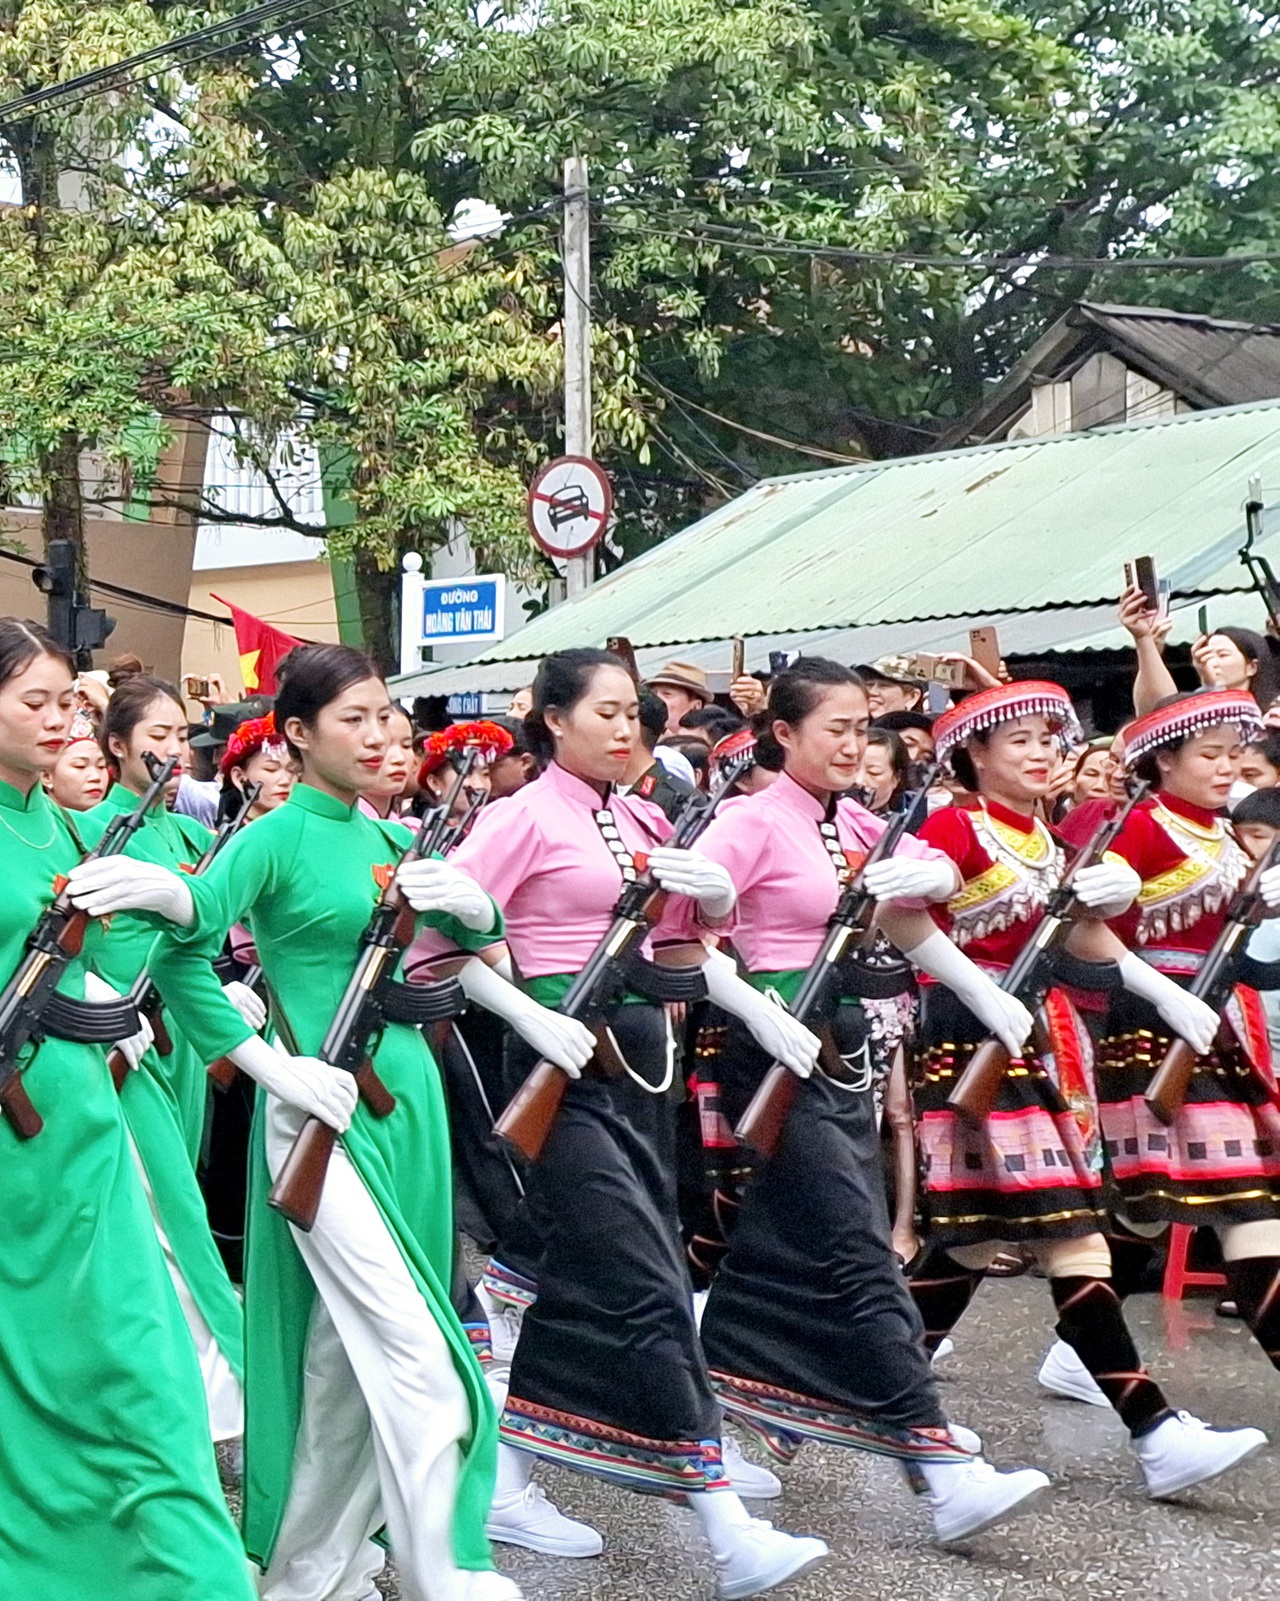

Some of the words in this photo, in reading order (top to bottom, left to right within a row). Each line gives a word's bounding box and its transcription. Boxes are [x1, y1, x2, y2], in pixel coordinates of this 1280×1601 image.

[440, 587, 478, 604] ĐƯỜNG
[426, 608, 453, 634] HOÀNG
[455, 607, 472, 632] VĂN
[473, 605, 492, 631] THÁI
